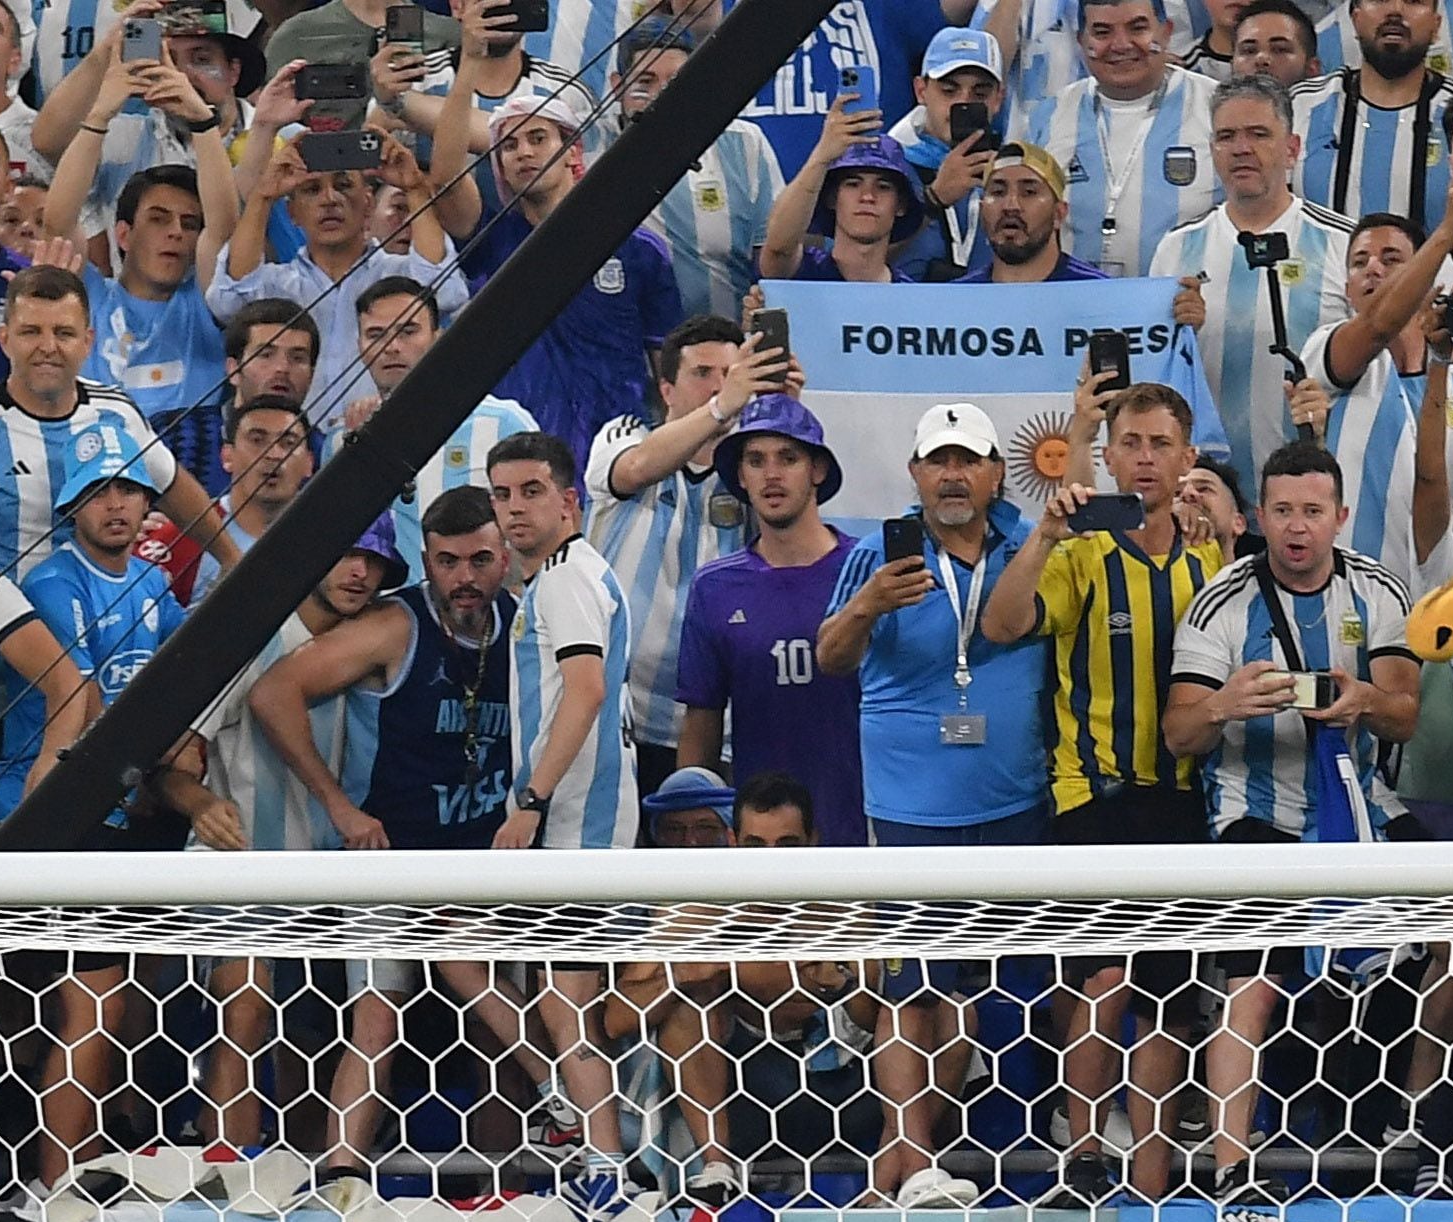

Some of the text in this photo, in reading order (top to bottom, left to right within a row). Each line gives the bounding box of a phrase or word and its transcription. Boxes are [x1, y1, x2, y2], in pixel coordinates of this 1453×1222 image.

[61, 26, 95, 59] 10
[841, 324, 1187, 358] FORMOSA PES
[769, 638, 813, 686] 10
